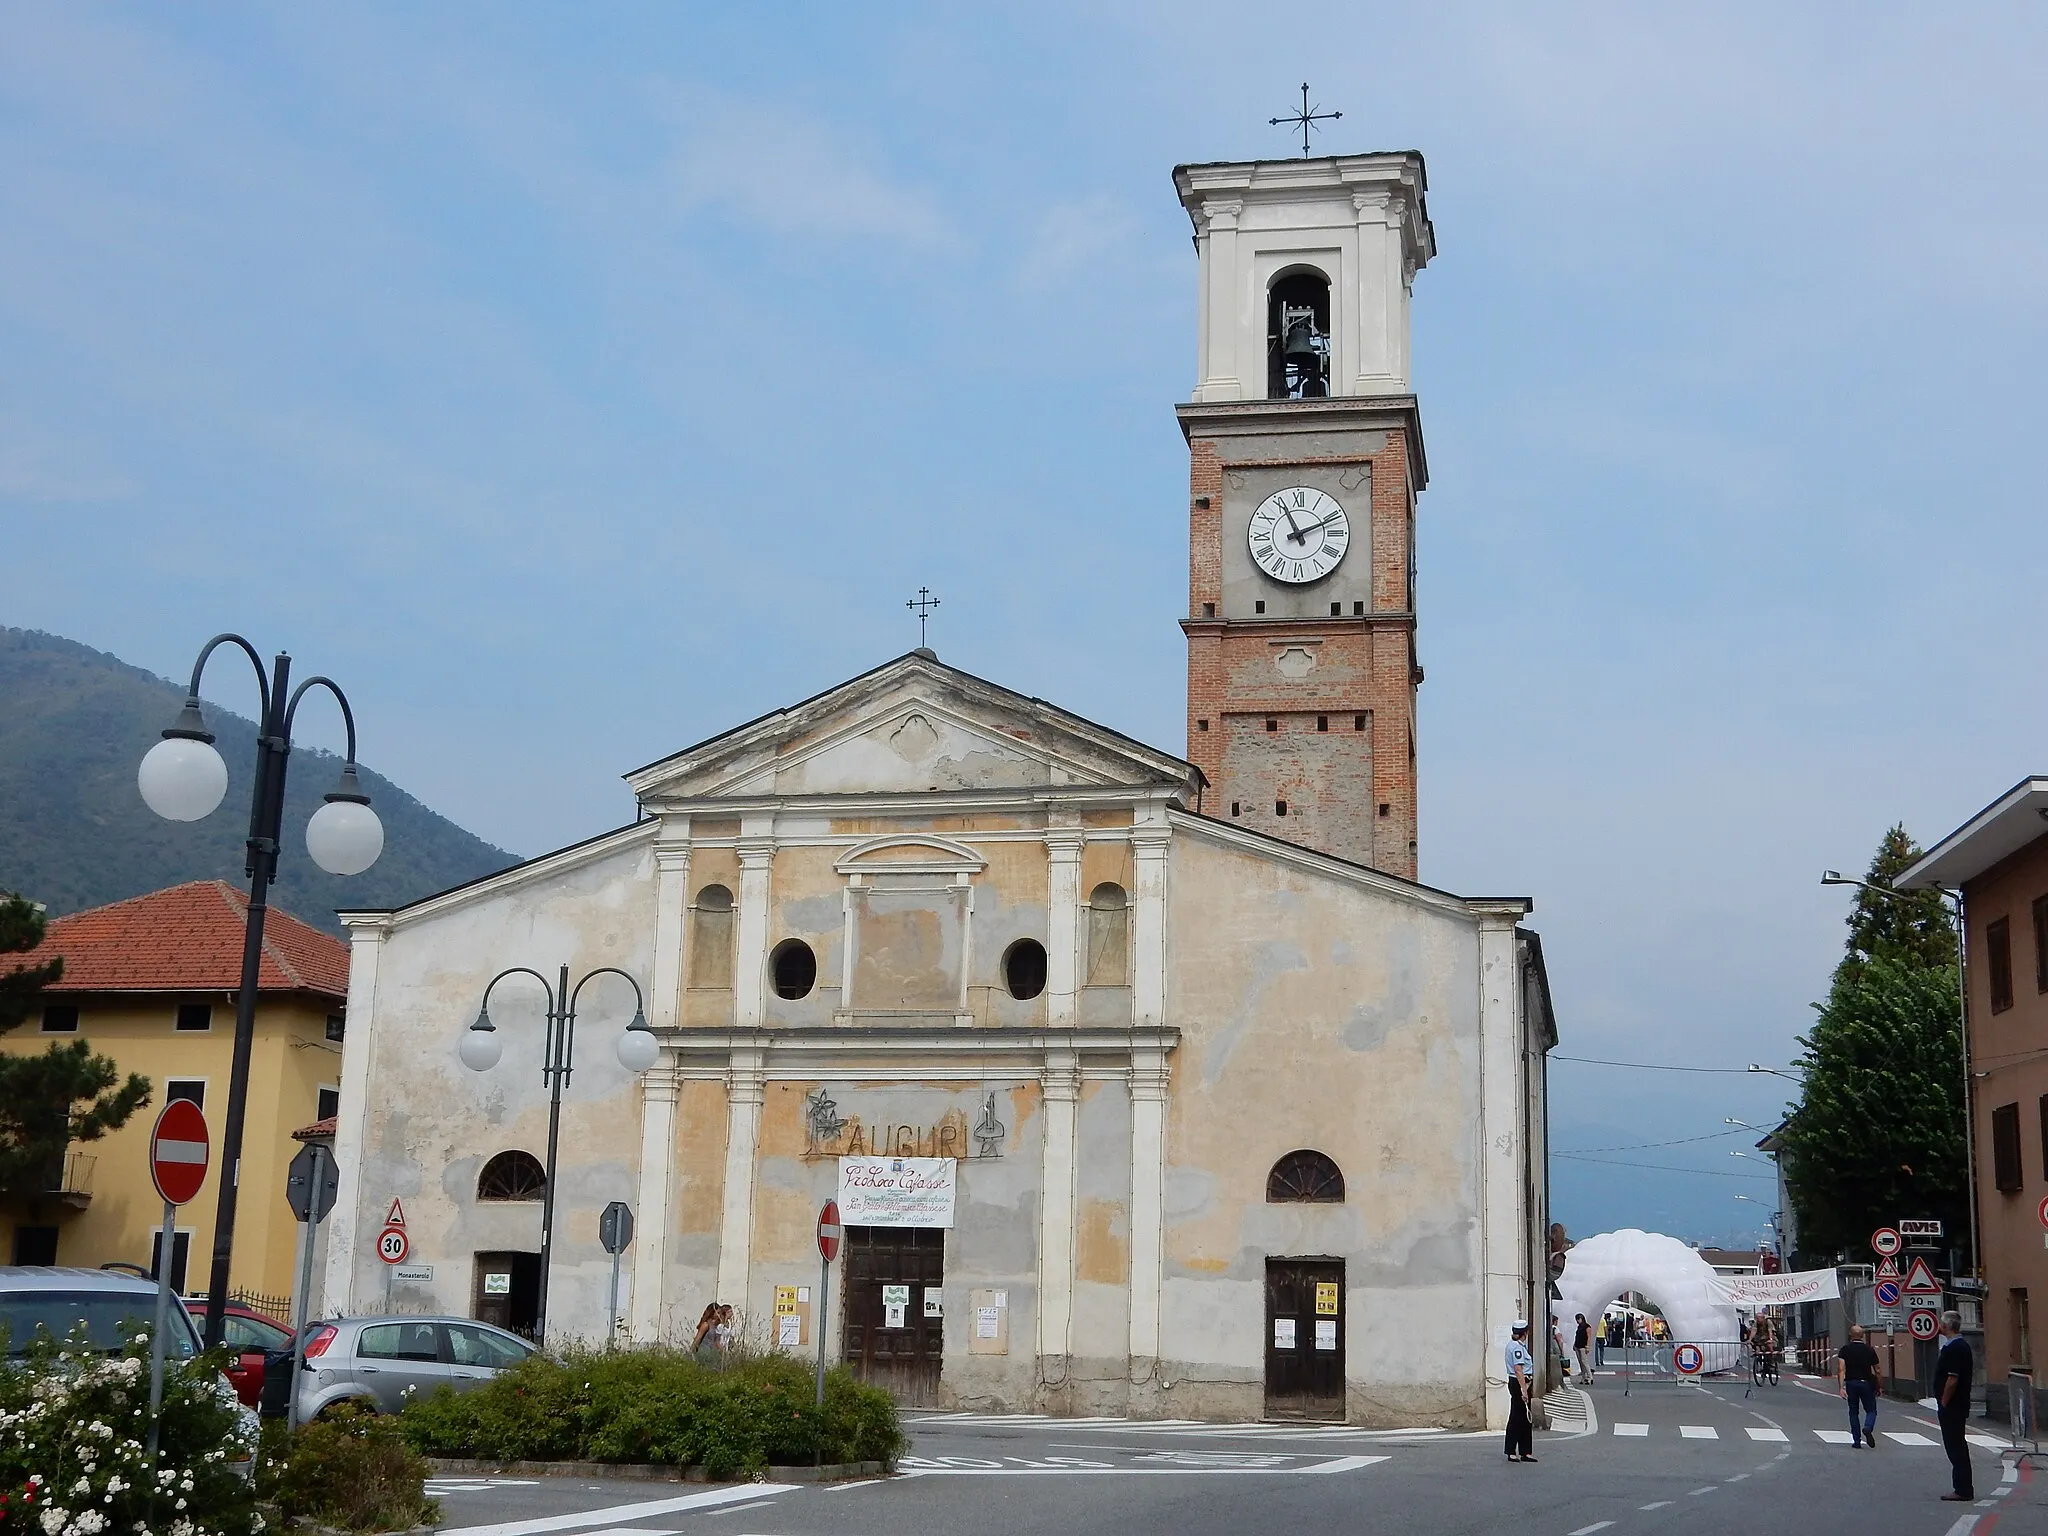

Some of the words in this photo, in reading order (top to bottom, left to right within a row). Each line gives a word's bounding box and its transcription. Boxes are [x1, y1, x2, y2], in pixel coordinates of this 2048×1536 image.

[1292, 491, 1305, 508] XII
[1258, 511, 1276, 525] X
[1253, 531, 1271, 541] IX
[1327, 529, 1344, 537] III
[1256, 545, 1275, 564] VIII
[1270, 557, 1286, 576] VII
[1293, 562, 1304, 579] VI
[1312, 558, 1325, 574] V
[847, 1124, 968, 1158] AUGURI
[898, 1167, 951, 1194] Cafasse
[1901, 1221, 1940, 1233] AVIS
[384, 1237, 402, 1254] 30
[397, 1272, 430, 1280] Monasterolo
[1732, 1277, 1795, 1289] VENDITORI
[1728, 1288, 1749, 1303] PER
[1753, 1289, 1771, 1302] UN
[1776, 1280, 1820, 1303] GIORNO
[1909, 1297, 1923, 1306] 20
[1914, 1317, 1933, 1332] 30
